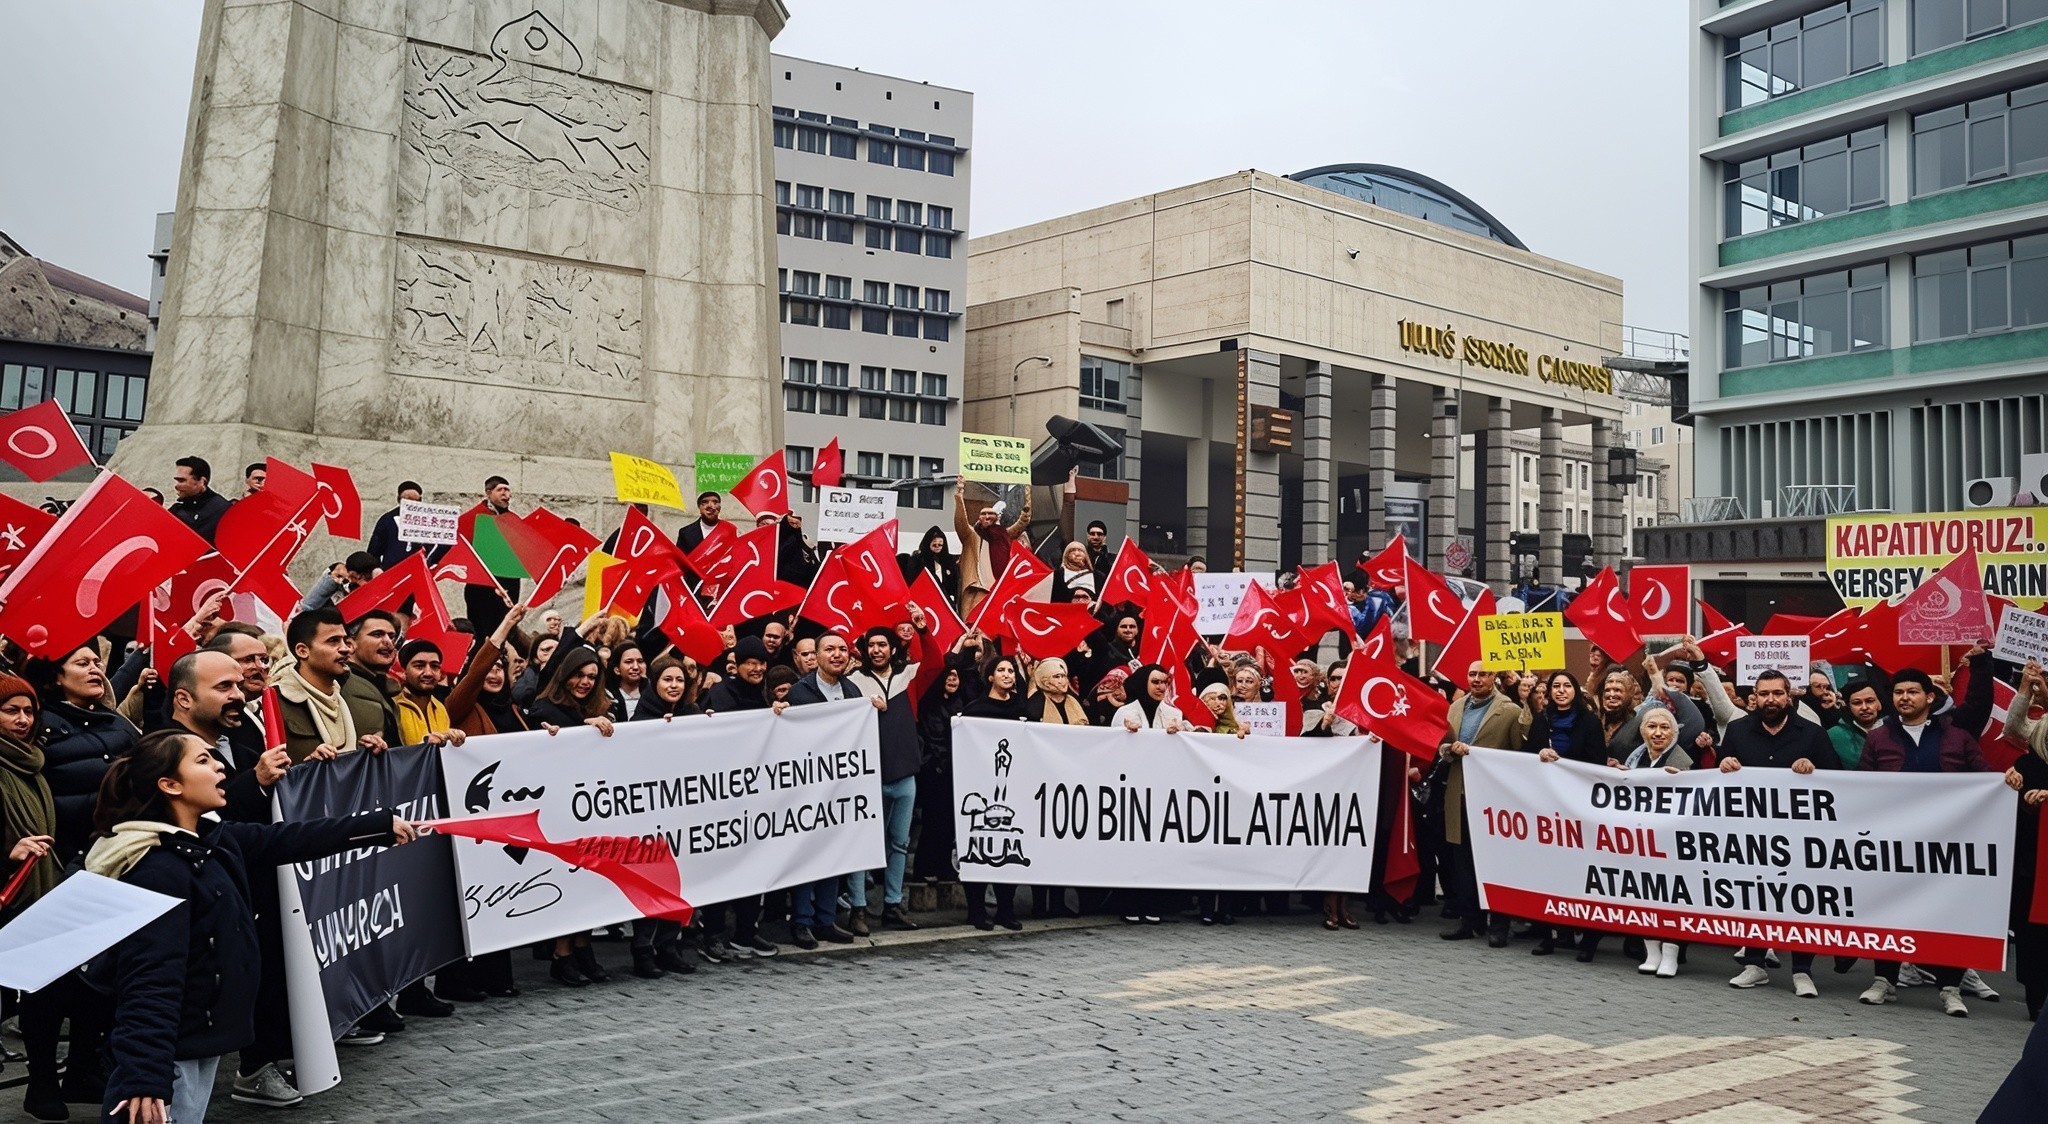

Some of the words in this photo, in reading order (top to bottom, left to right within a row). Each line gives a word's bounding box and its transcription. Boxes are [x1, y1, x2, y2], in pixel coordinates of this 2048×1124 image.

[1983, 564, 2047, 597] ARIN
[1034, 782, 1089, 840] 100
[1098, 773, 1152, 842] BİN
[1159, 775, 1242, 845] ADİL
[1245, 792, 1368, 847] ATAMA
[1483, 806, 1528, 841] 100
[1536, 811, 1584, 850] BİN
[1803, 830, 1998, 877] DAĞILIMLI
[1584, 864, 1694, 906] ATAMA
